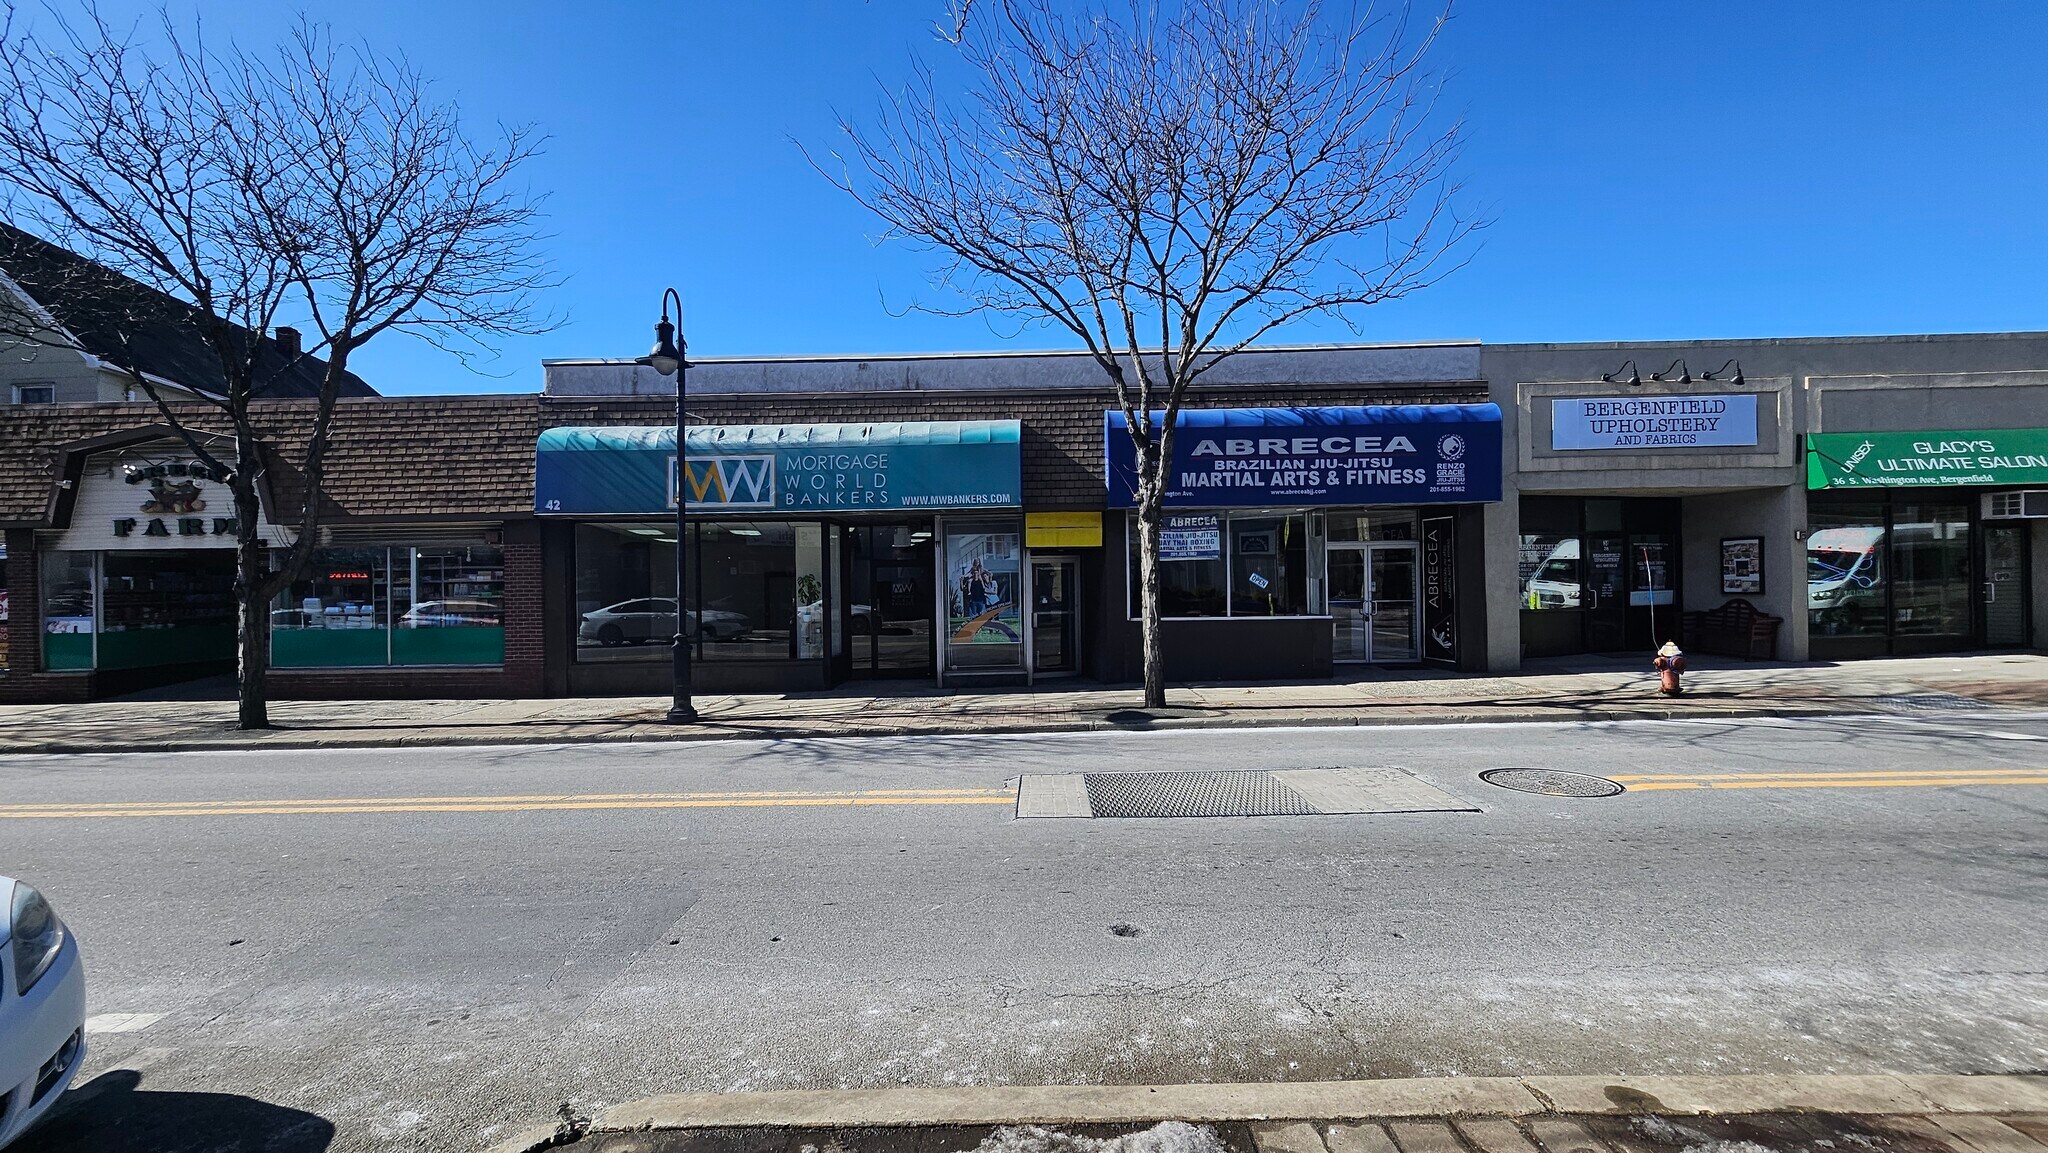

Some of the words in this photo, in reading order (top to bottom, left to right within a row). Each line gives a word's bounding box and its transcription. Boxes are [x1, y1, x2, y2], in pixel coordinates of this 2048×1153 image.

[1584, 399, 1726, 416] BERGENFIELD
[1590, 417, 1721, 433] UPHOLSTERY
[1614, 434, 1642, 445] AND
[1645, 433, 1697, 445] FABRICS
[1191, 436, 1417, 456] ABRECEA
[1913, 440, 1995, 454] GLACY'S
[786, 453, 889, 471] MORTGAGE
[1214, 459, 1305, 470] BRAZILIAN
[1310, 457, 1393, 469] JIU-JITSU
[1841, 440, 1875, 474] UNISEX
[1877, 457, 1975, 471] ULTIMATE
[1978, 454, 2048, 469] SALON
[1436, 462, 1466, 470] RENZO
[784, 473, 887, 489] WORLD
[1181, 472, 1265, 488] MARTIAL
[1270, 470, 1320, 487] ARTS
[1326, 470, 1340, 486] &
[1346, 468, 1426, 485] FITNESS
[1849, 477, 1859, 485] S.
[1863, 475, 1918, 486] Washington
[1941, 474, 1995, 485] Bergenfield
[785, 490, 889, 505] BANKERS
[1270, 488, 1327, 497] www.abreceabjj.com
[544, 500, 561, 511] 42
[901, 493, 1011, 506] WWW.MWBANKERS.COM
[1169, 516, 1218, 528] ABRECEA
[1186, 531, 1218, 539] JIU-JITSU
[1190, 538, 1215, 546] BOXING
[1427, 529, 1439, 609] ABRECEA
[1251, 575, 1266, 587] OPEN
